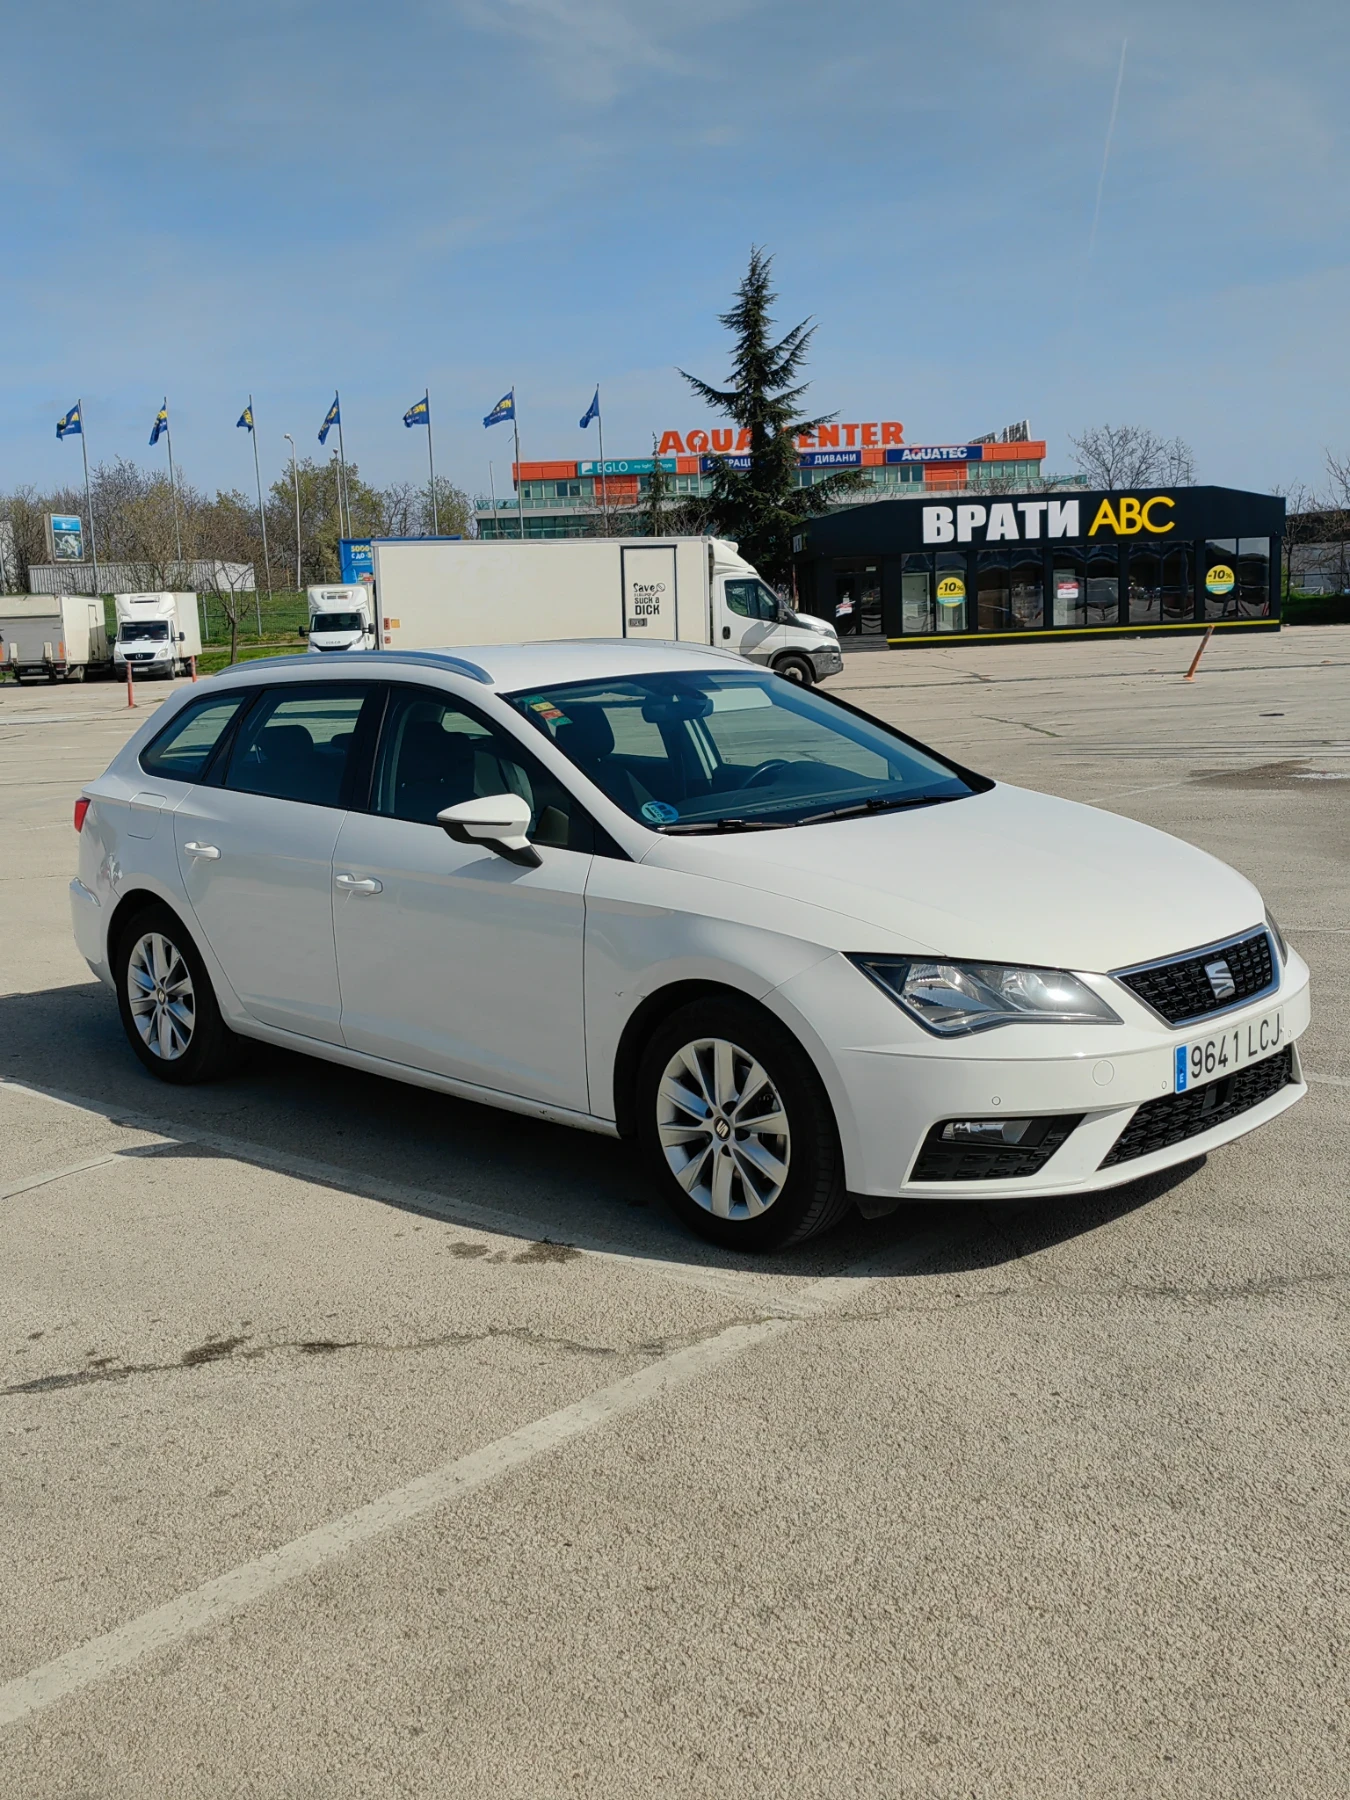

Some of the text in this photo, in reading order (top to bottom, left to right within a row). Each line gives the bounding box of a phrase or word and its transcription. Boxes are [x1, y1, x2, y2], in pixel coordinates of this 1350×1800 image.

[658, 421, 905, 455] AQUA ENTER
[814, 453, 857, 465] ДИВАНИ
[902, 447, 968, 460] AQUATEC
[597, 461, 629, 473] EGLO
[922, 496, 1175, 543] ВРАТИ ABC
[1208, 569, 1232, 580] -10%
[633, 582, 655, 592] Save
[939, 582, 964, 592] -10%
[635, 604, 660, 615] DICK
[1191, 1031, 1239, 1079] 9641
[1248, 1013, 1280, 1057] LCJ
